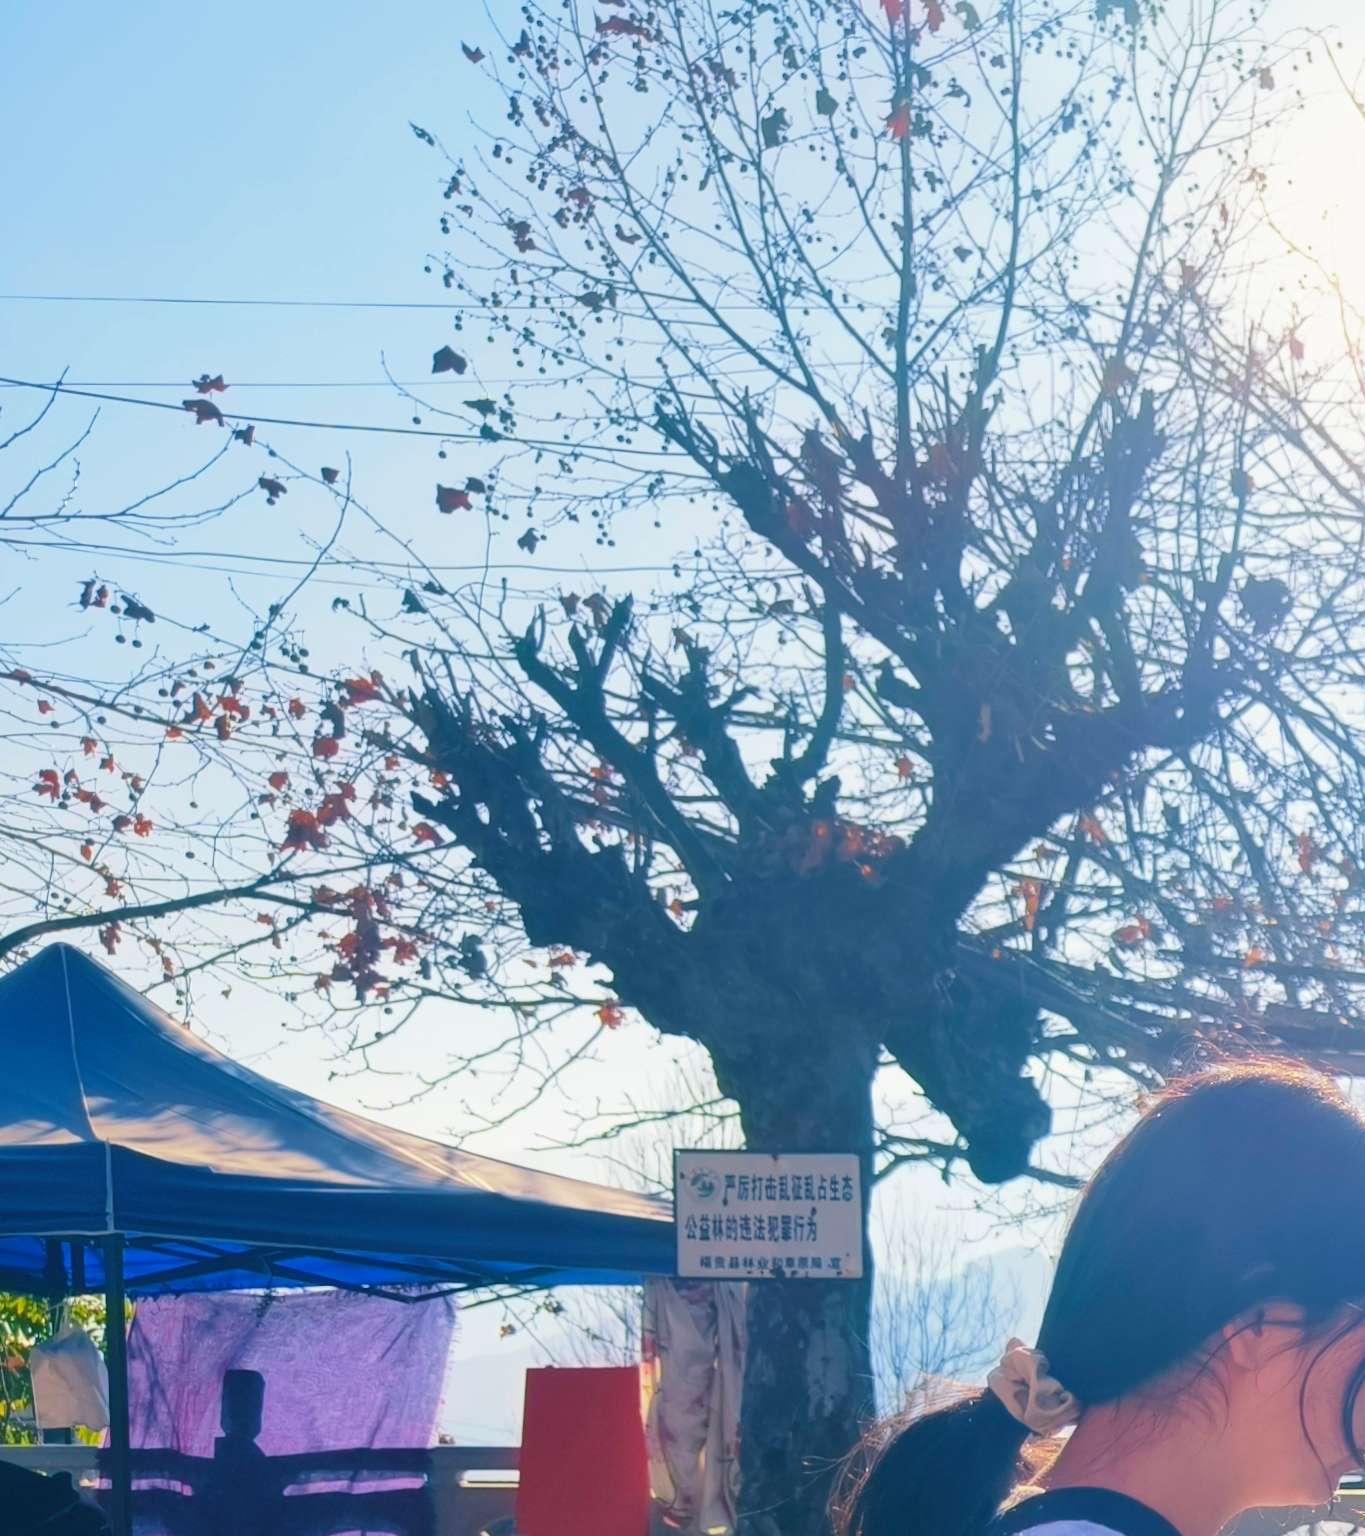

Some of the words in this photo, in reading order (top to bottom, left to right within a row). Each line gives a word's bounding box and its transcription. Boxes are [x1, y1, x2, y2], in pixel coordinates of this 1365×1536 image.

[723, 1174, 853, 1202] 严厉打击乱征乱占生态
[685, 1213, 818, 1243] 公益林的违法犯罪行为
